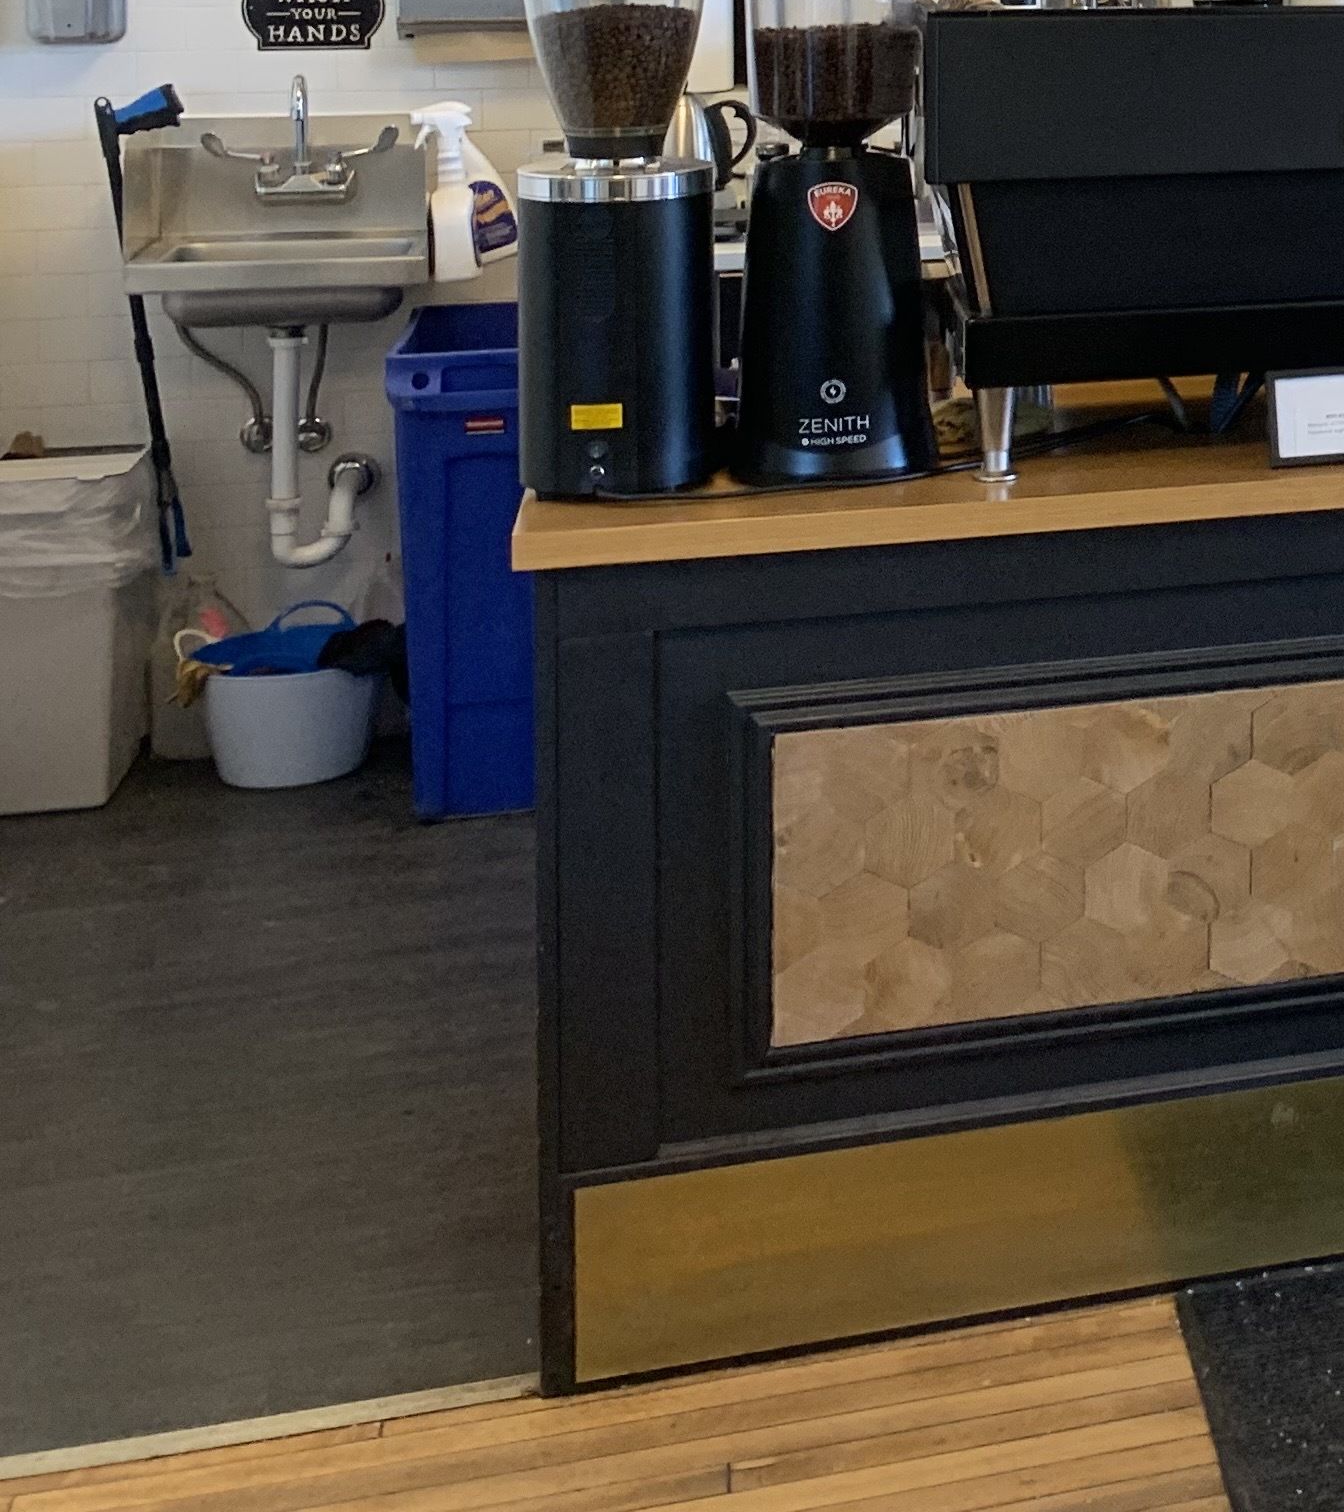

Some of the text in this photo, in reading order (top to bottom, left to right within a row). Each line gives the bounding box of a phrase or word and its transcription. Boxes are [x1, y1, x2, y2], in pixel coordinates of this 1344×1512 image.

[290, 8, 337, 20] YOUR
[267, 24, 360, 42] HANDS
[799, 415, 870, 434] ZENITH
[836, 434, 866, 445] SPEED
